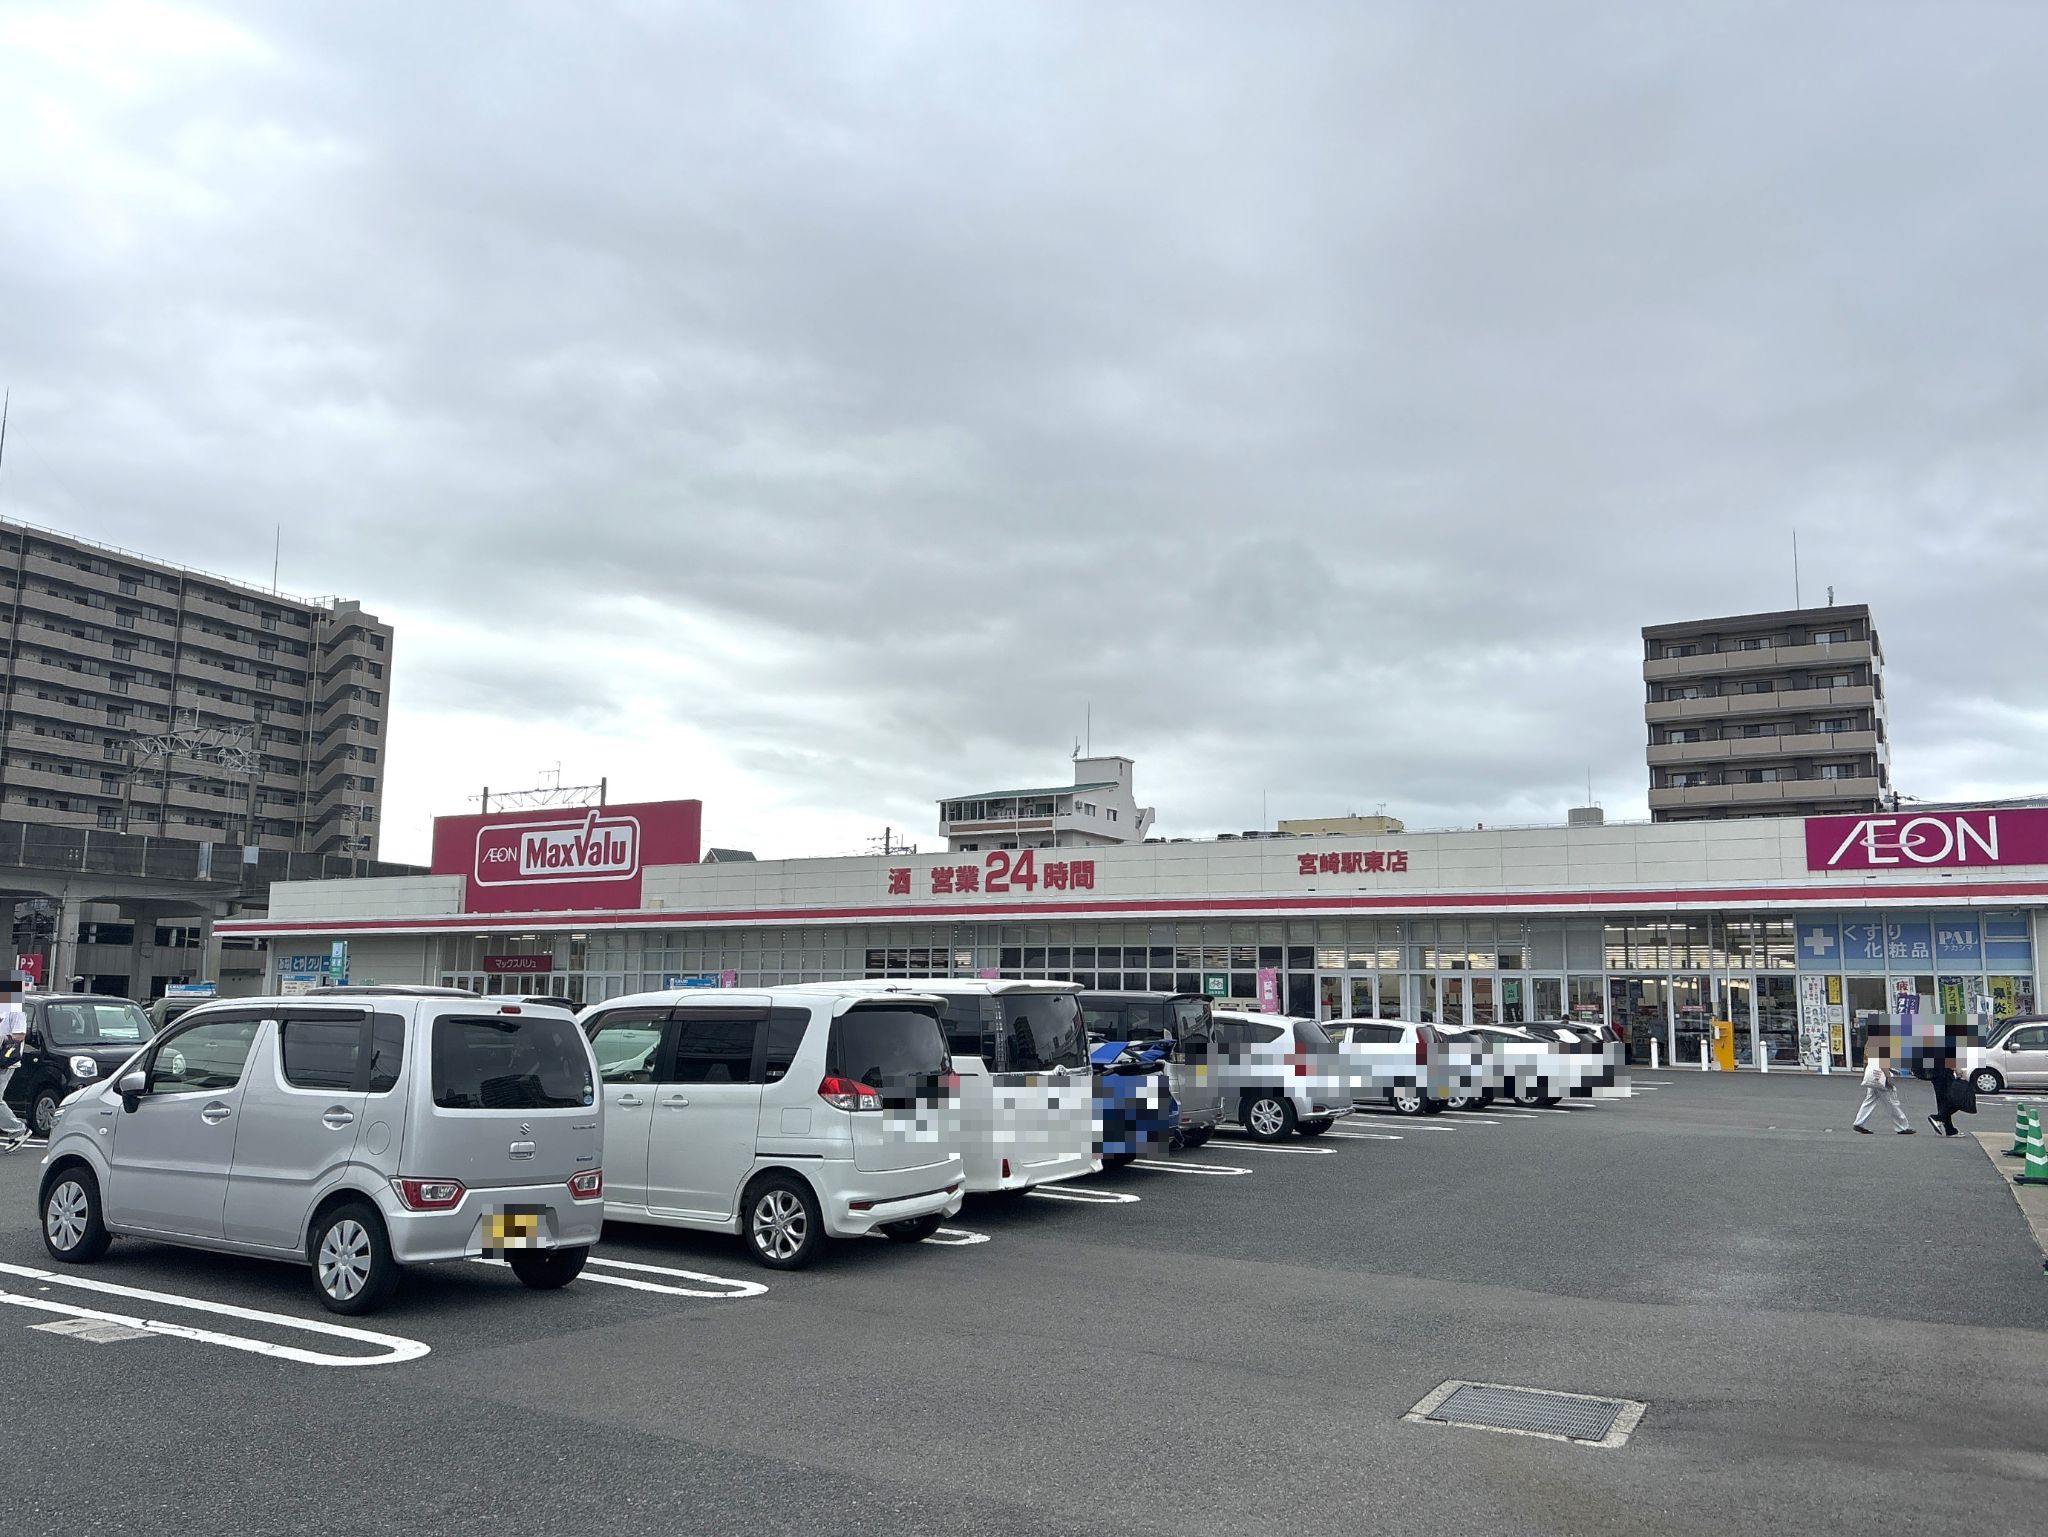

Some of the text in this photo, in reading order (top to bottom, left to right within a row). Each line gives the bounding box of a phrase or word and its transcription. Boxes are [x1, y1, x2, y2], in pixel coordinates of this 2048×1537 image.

[525, 813, 627, 869] MaxValu
[1827, 815, 1999, 865] AEON
[888, 849, 1095, 895] 酒 営業24時間
[1297, 850, 1408, 875] 宮崎駅東店
[1843, 924, 1902, 941] くすり
[1938, 930, 1978, 945] PAL
[1864, 942, 1929, 958] 化粧品
[20, 957, 27, 969] P
[495, 958, 537, 968] マックスバリュ
[1993, 987, 2007, 1015] 鼻炎
